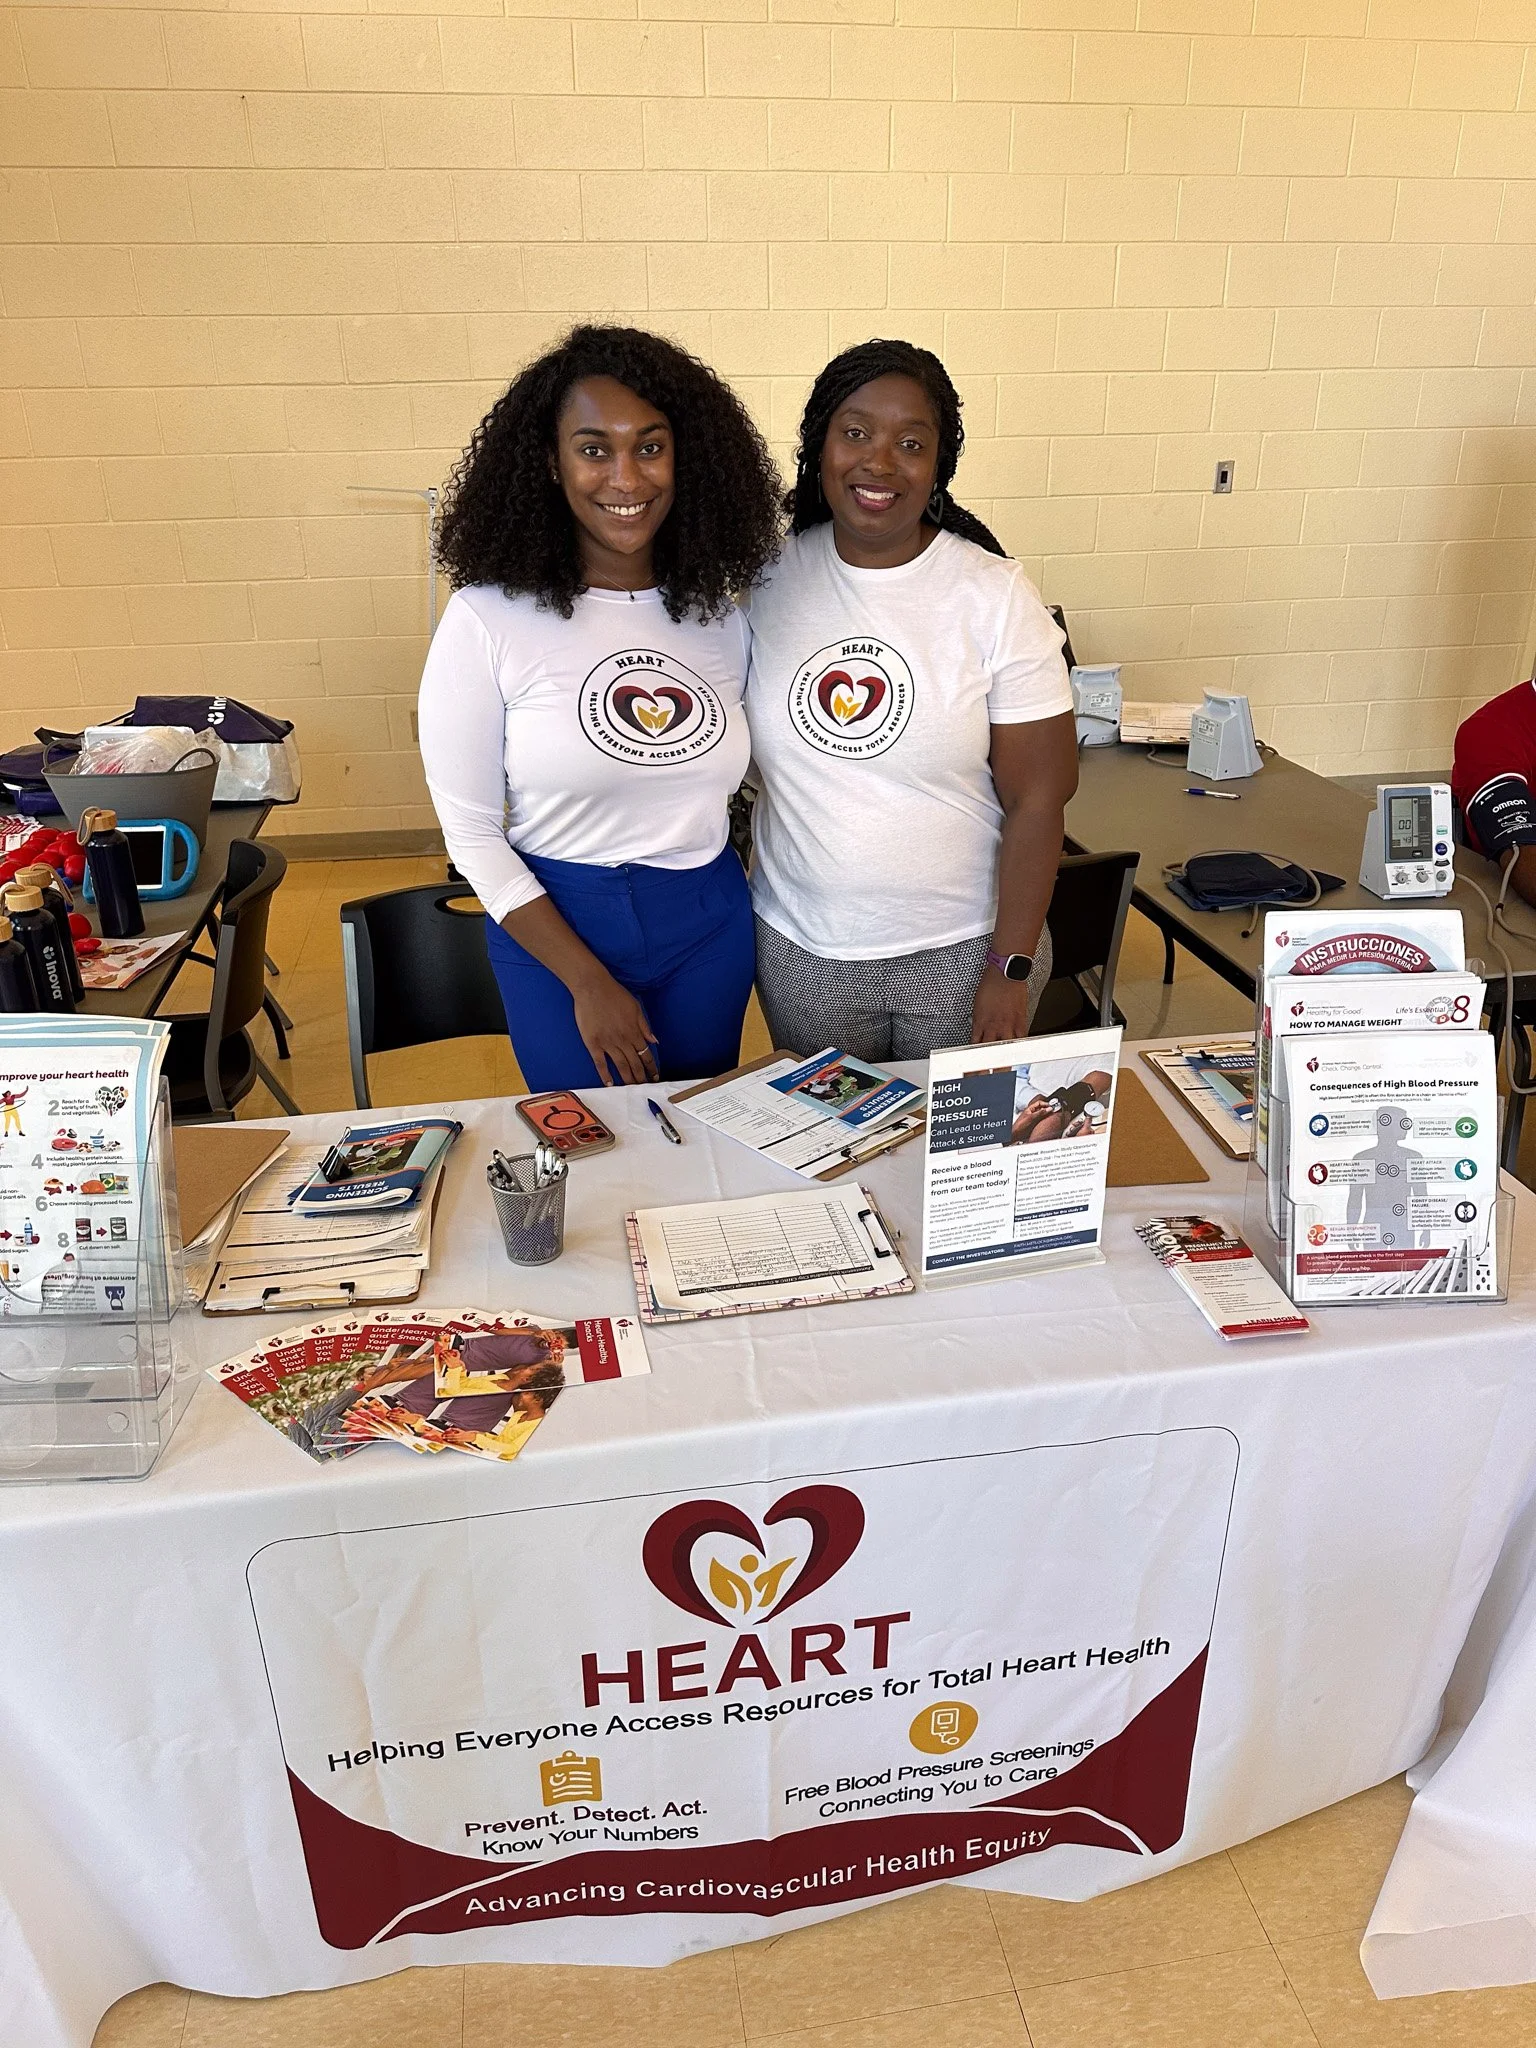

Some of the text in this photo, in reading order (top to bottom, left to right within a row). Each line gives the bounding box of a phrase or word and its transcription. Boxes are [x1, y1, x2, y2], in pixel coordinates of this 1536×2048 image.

[841, 643, 884, 657] HEART
[615, 655, 665, 669] HEART
[796, 671, 905, 753] HELPING EVERYONE ACCESS TOTAL RESOURCES
[589, 686, 718, 758] HELPING EVERYONE ACCESS TOTAL RESOURCES
[1492, 799, 1527, 813] OMRON
[1300, 937, 1424, 969] INSTRUCCIONES
[1309, 961, 1326, 974] PARA
[1327, 953, 1347, 966] MEDIR
[1358, 950, 1385, 960] PRESIÓN
[1385, 955, 1414, 972] ARTERIAL
[45, 960, 62, 1000] Inova
[1306, 1009, 1331, 1017] Healthy
[1332, 1008, 1342, 1016] for
[1414, 1006, 1446, 1014] Essential
[1450, 995, 1471, 1023] 8
[1289, 1021, 1314, 1029] HOW
[1326, 1020, 1366, 1028] MANAGE
[1367, 1018, 1402, 1026] WEIGHT
[39, 1074, 64, 1082] your
[65, 1071, 94, 1079] heart
[95, 1069, 129, 1079] health
[933, 1083, 961, 1095] HIGH
[1309, 1079, 1479, 1092] Consequences of High Blood Pressure
[48, 1099, 60, 1116] 2
[860, 1090, 894, 1111] RESULTS
[862, 1090, 906, 1118] SCREENING
[932, 1096, 971, 1110] BLOOD
[931, 1107, 988, 1124] PRESSURE
[930, 1128, 947, 1137] Can
[950, 1124, 971, 1134] Lead
[983, 1119, 1007, 1129] Heart
[930, 1132, 995, 1149] Attack & Stroke
[31, 1153, 44, 1169] 4
[931, 1165, 962, 1175] Receive
[970, 1160, 992, 1169] blood
[338, 1180, 386, 1191] RESULTS
[931, 1169, 1004, 1187] pressure screening
[325, 1185, 390, 1199] SCREENING
[930, 1188, 949, 1196] from
[965, 1183, 985, 1191] team
[986, 1178, 1010, 1188] today!
[35, 1196, 48, 1211] 6
[57, 1232, 70, 1248] 8
[1184, 1241, 1225, 1249] PREGNANCY
[931, 1257, 956, 1265] CONTACT
[584, 1321, 593, 1343] Snacks
[594, 1320, 608, 1365] Heart-Healthy
[279, 1354, 299, 1363] and
[581, 1611, 911, 1708] HEART
[327, 1636, 1171, 1772] Helping Everyone Access Resources for Total Heart Health
[784, 1738, 1095, 1805] Free Blood Pressure Screenings
[819, 1764, 1059, 1818] Connecting You to Care
[464, 1799, 708, 1837] Prevent. Detect. Act.
[482, 1824, 699, 1856] Know Your Numbers
[465, 1826, 1051, 1915] Advancing Cardiovascular Health Equity
